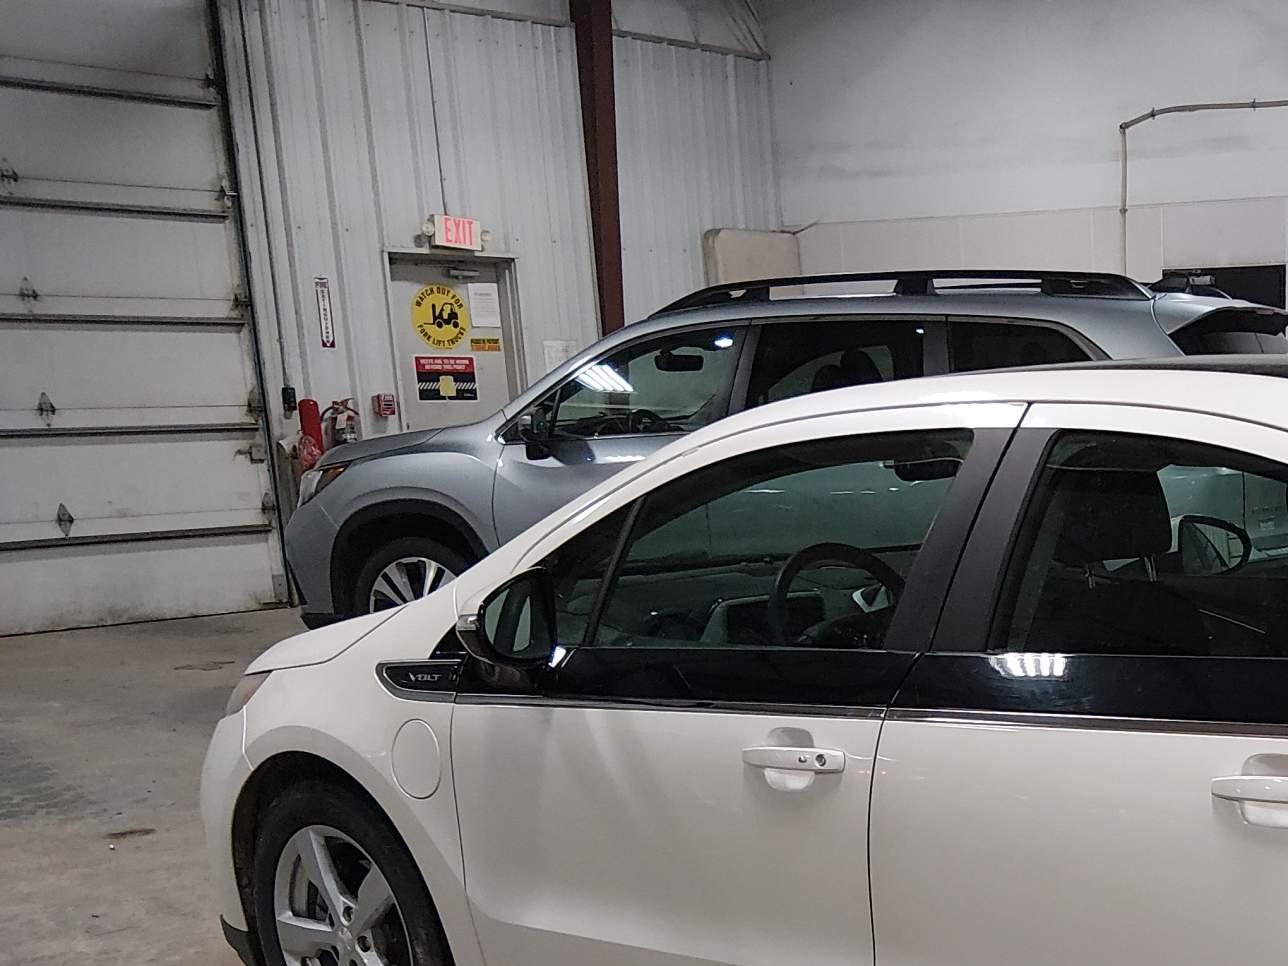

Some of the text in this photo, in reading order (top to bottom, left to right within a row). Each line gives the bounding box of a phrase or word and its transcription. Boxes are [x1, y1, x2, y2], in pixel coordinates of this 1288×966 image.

[444, 217, 473, 246] EXIT
[415, 286, 464, 309] WATCH OUT FOR
[417, 325, 467, 347] FORK LIFT TRUCKS
[408, 672, 441, 682] VOLT
